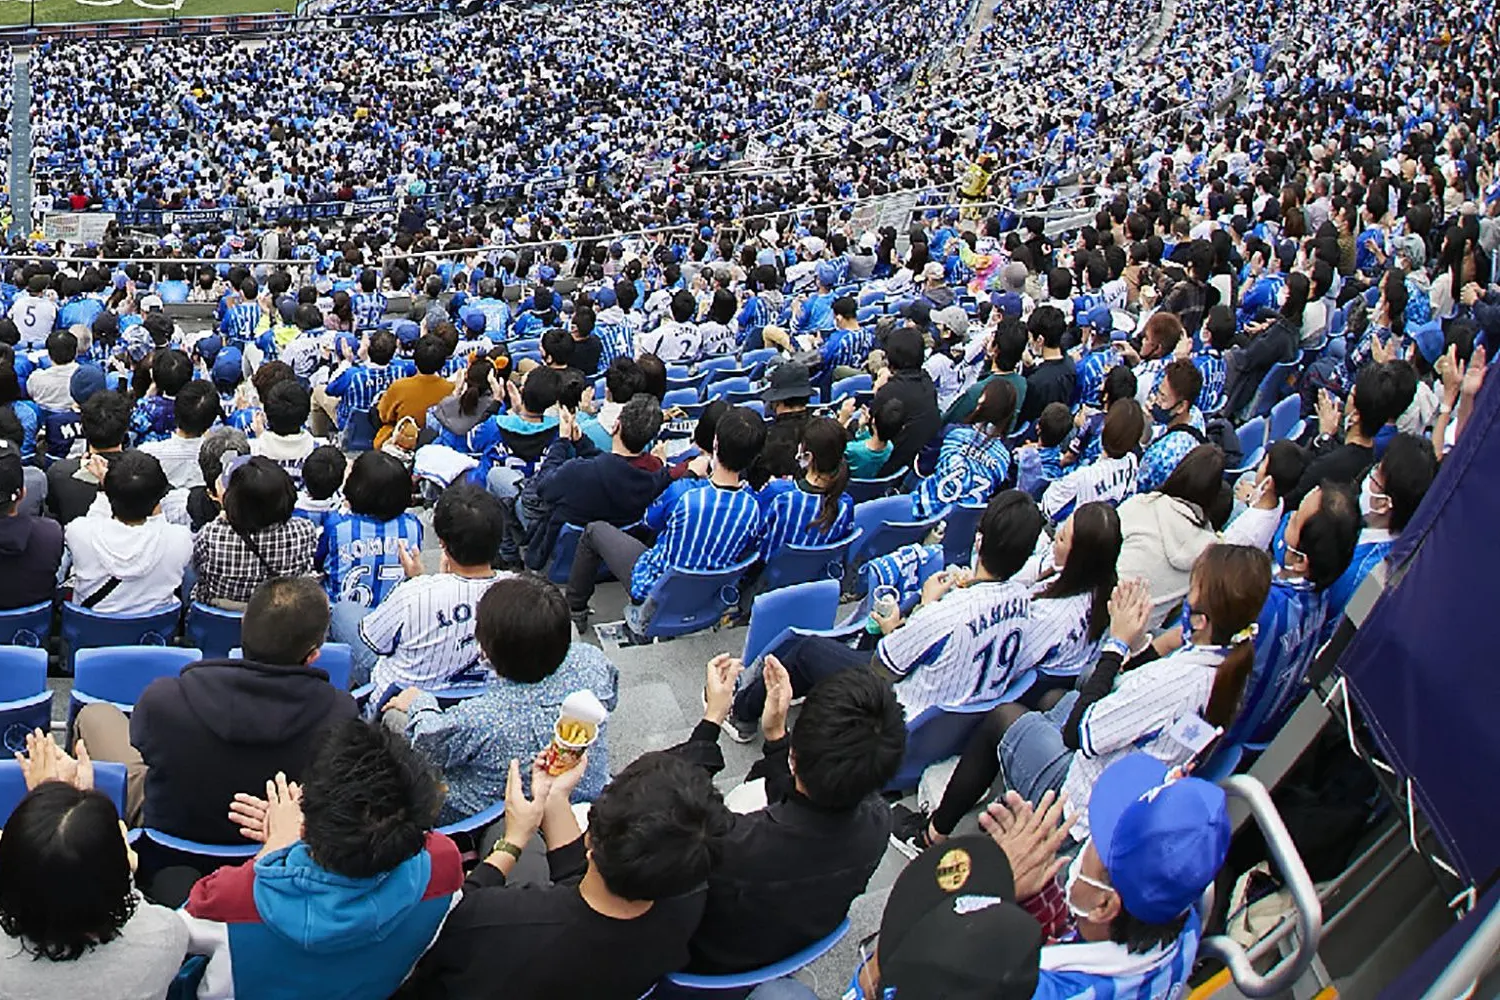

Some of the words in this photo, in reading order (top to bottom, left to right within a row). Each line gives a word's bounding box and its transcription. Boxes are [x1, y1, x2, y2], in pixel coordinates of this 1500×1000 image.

[24, 305, 37, 328] 5
[679, 339, 692, 360] 2
[936, 467, 992, 507] 63
[972, 627, 1023, 698] 19
